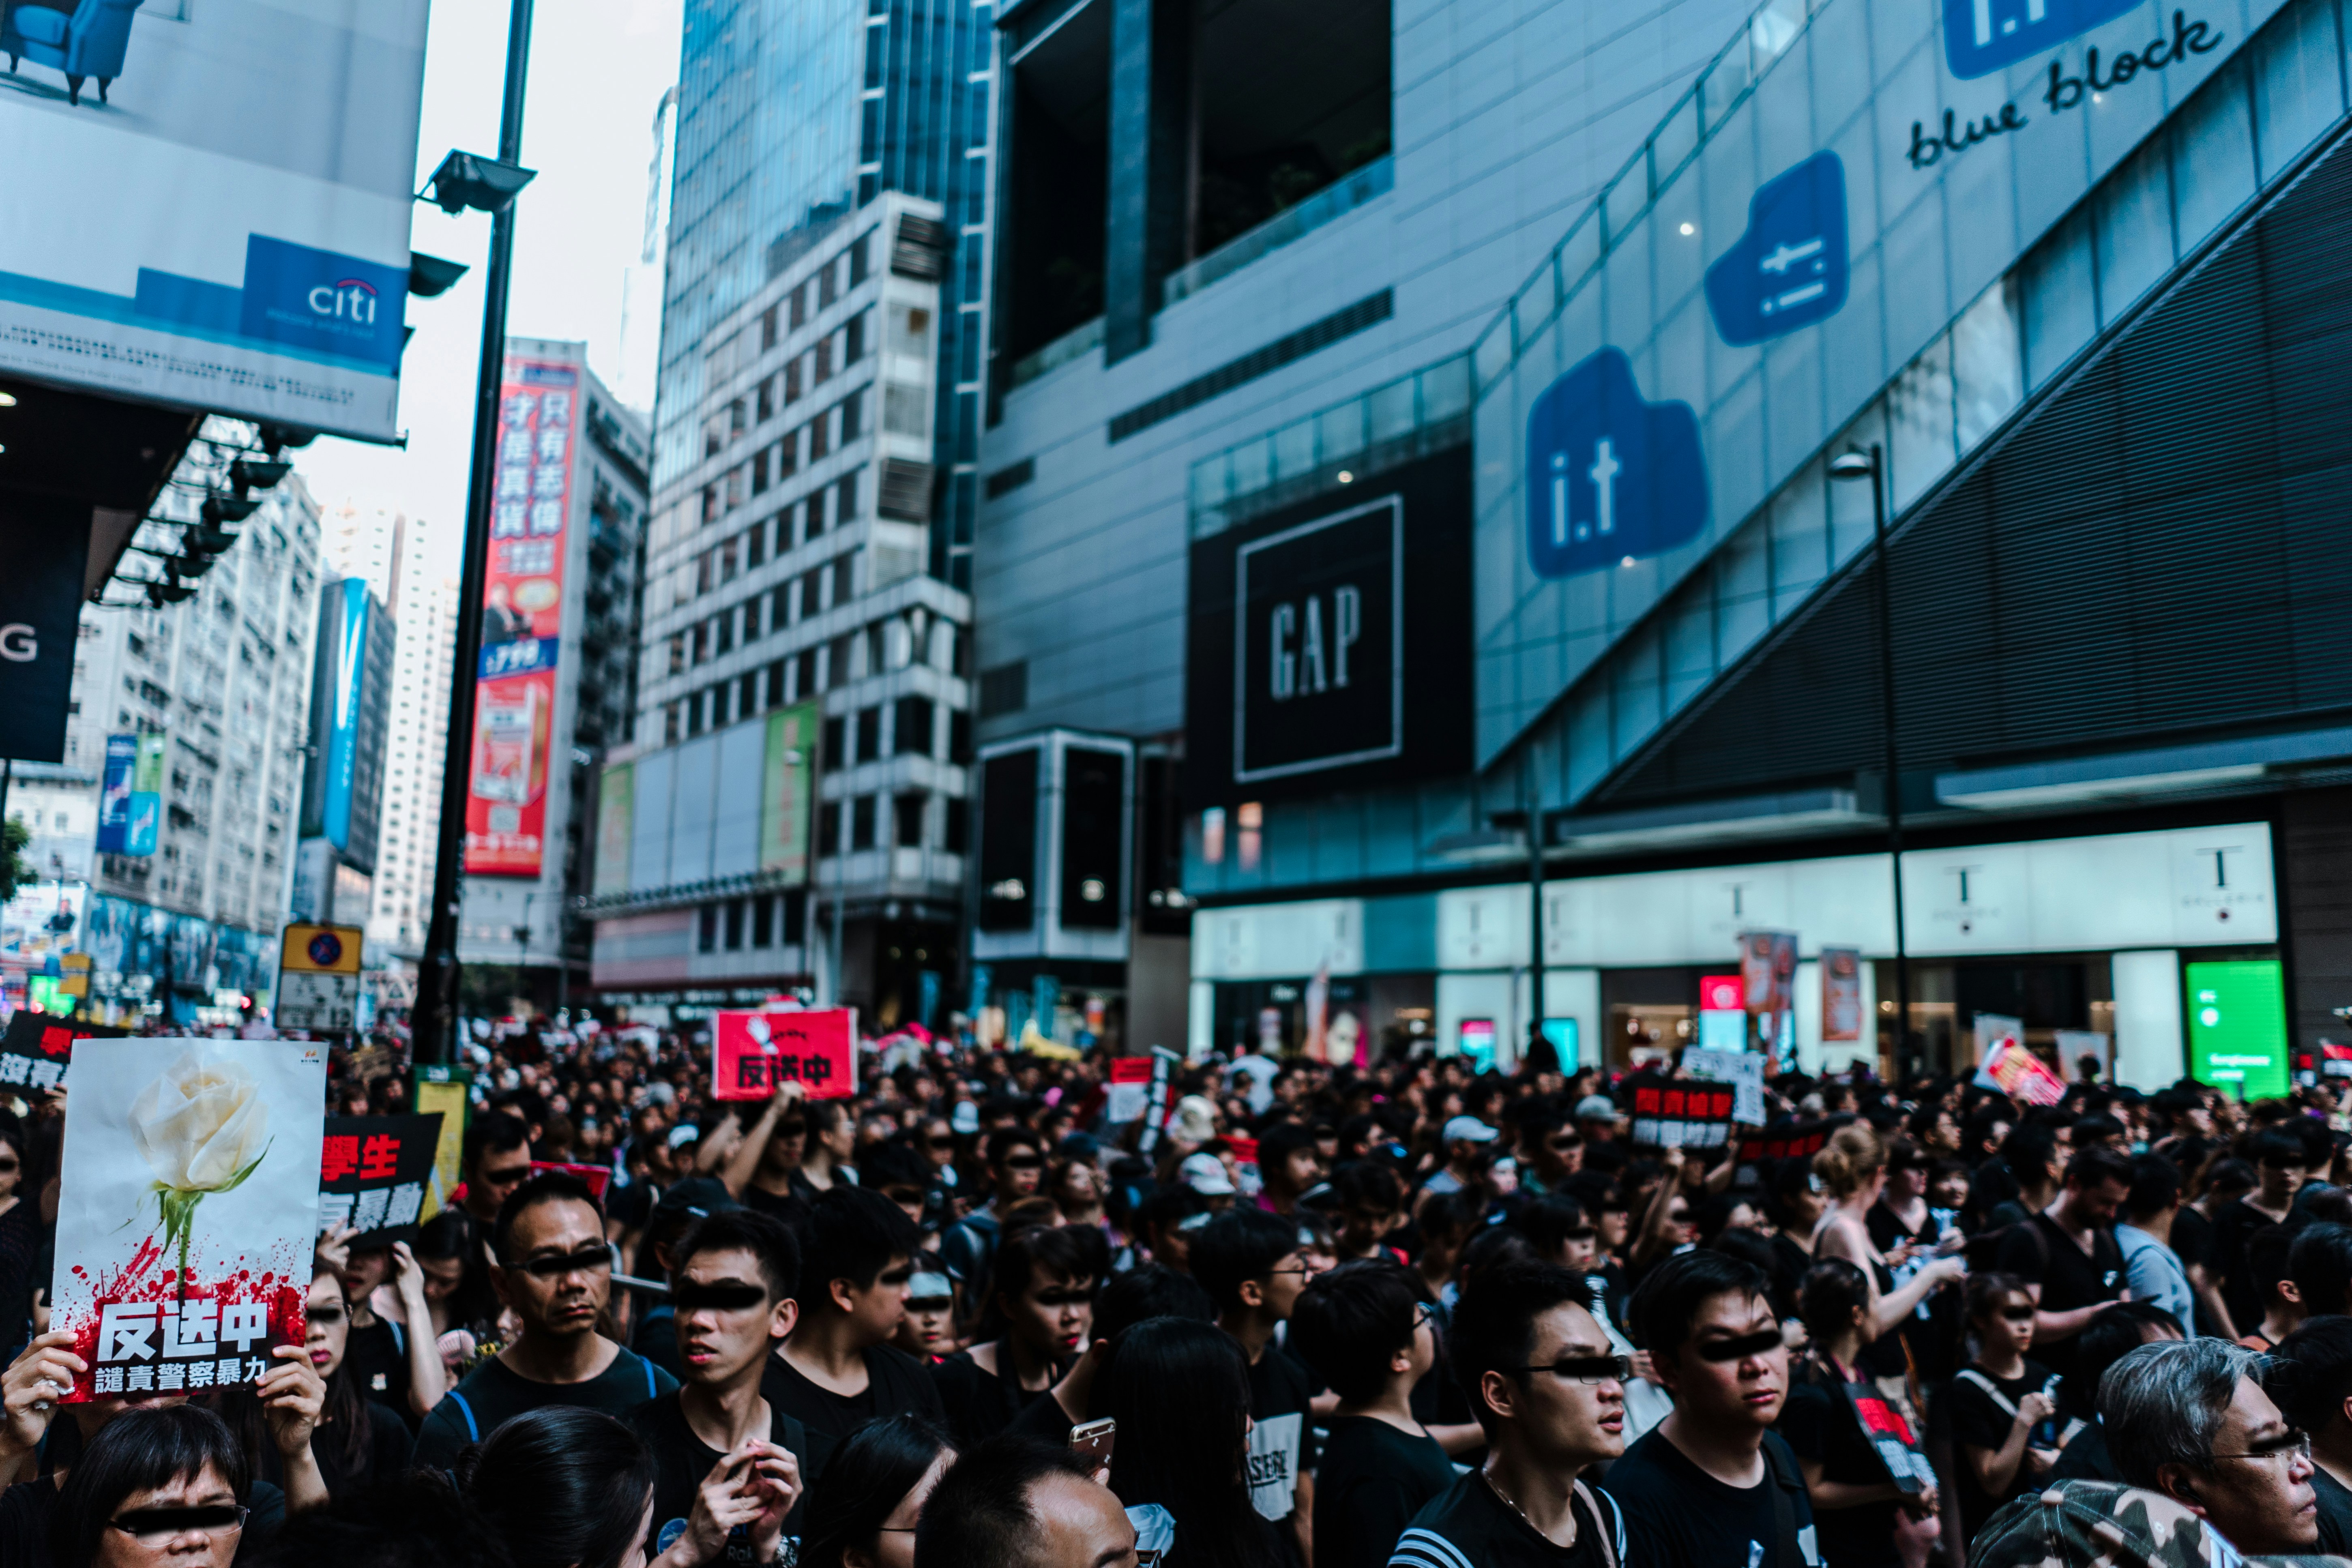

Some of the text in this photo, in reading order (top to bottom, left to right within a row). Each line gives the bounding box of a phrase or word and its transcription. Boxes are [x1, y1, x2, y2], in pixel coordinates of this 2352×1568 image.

[1907, 10, 2223, 169] blue block
[309, 280, 376, 324] citi
[1550, 437, 1621, 545] i.t
[1270, 584, 1361, 701] GAP
[738, 1055, 831, 1088] 反送中
[321, 1134, 401, 1182] 學生
[97, 1295, 267, 1362] 反送中
[94, 1356, 266, 1394] 譴責警察暴力
